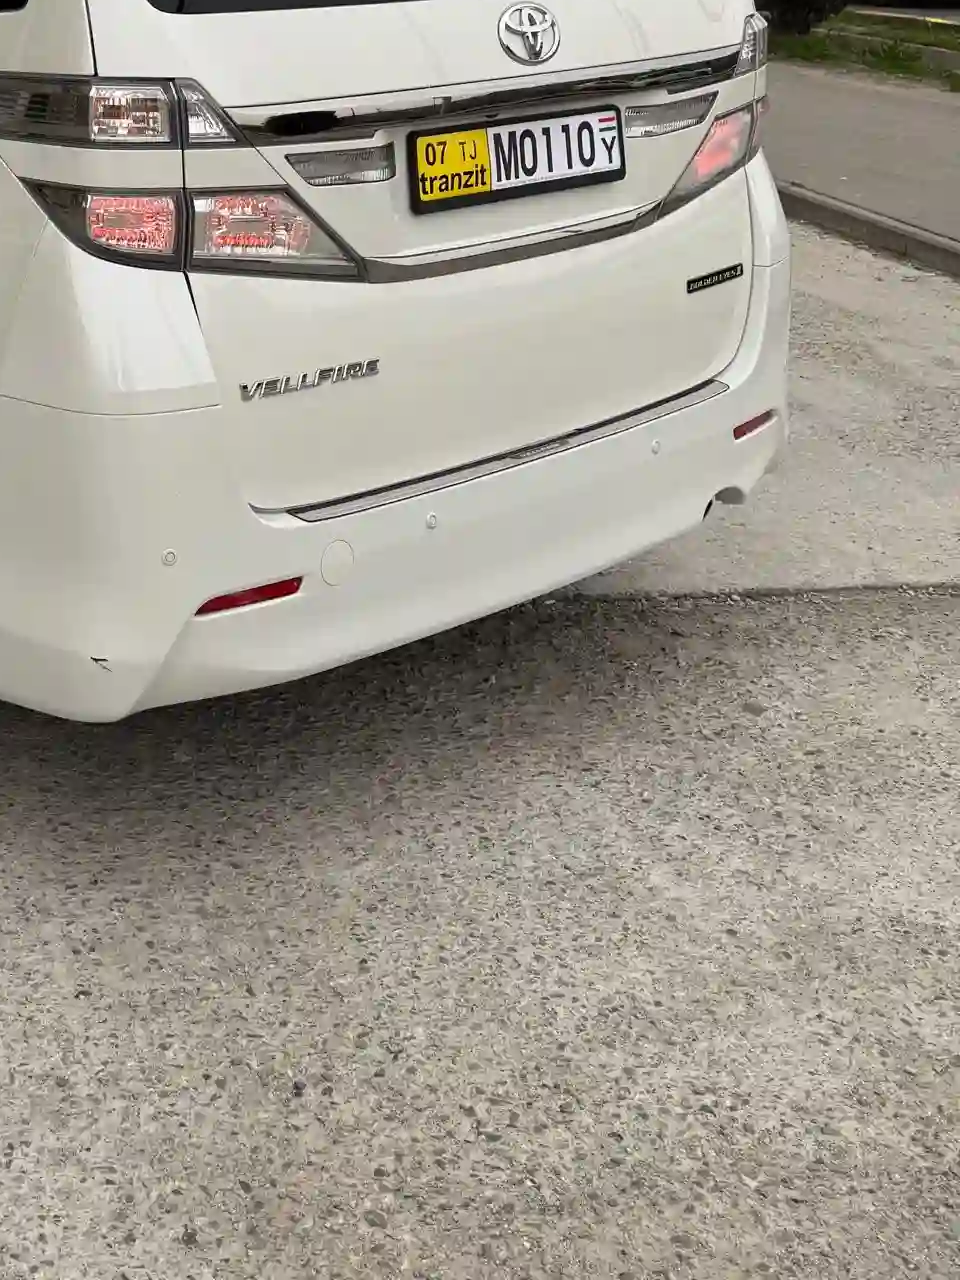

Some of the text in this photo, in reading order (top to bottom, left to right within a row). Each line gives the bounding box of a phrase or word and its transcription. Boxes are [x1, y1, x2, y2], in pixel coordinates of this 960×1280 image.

[425, 139, 477, 166] 07 TJ
[601, 136, 616, 164] Y
[419, 164, 487, 195] tranzit
[239, 357, 380, 400] VELLFIRE
